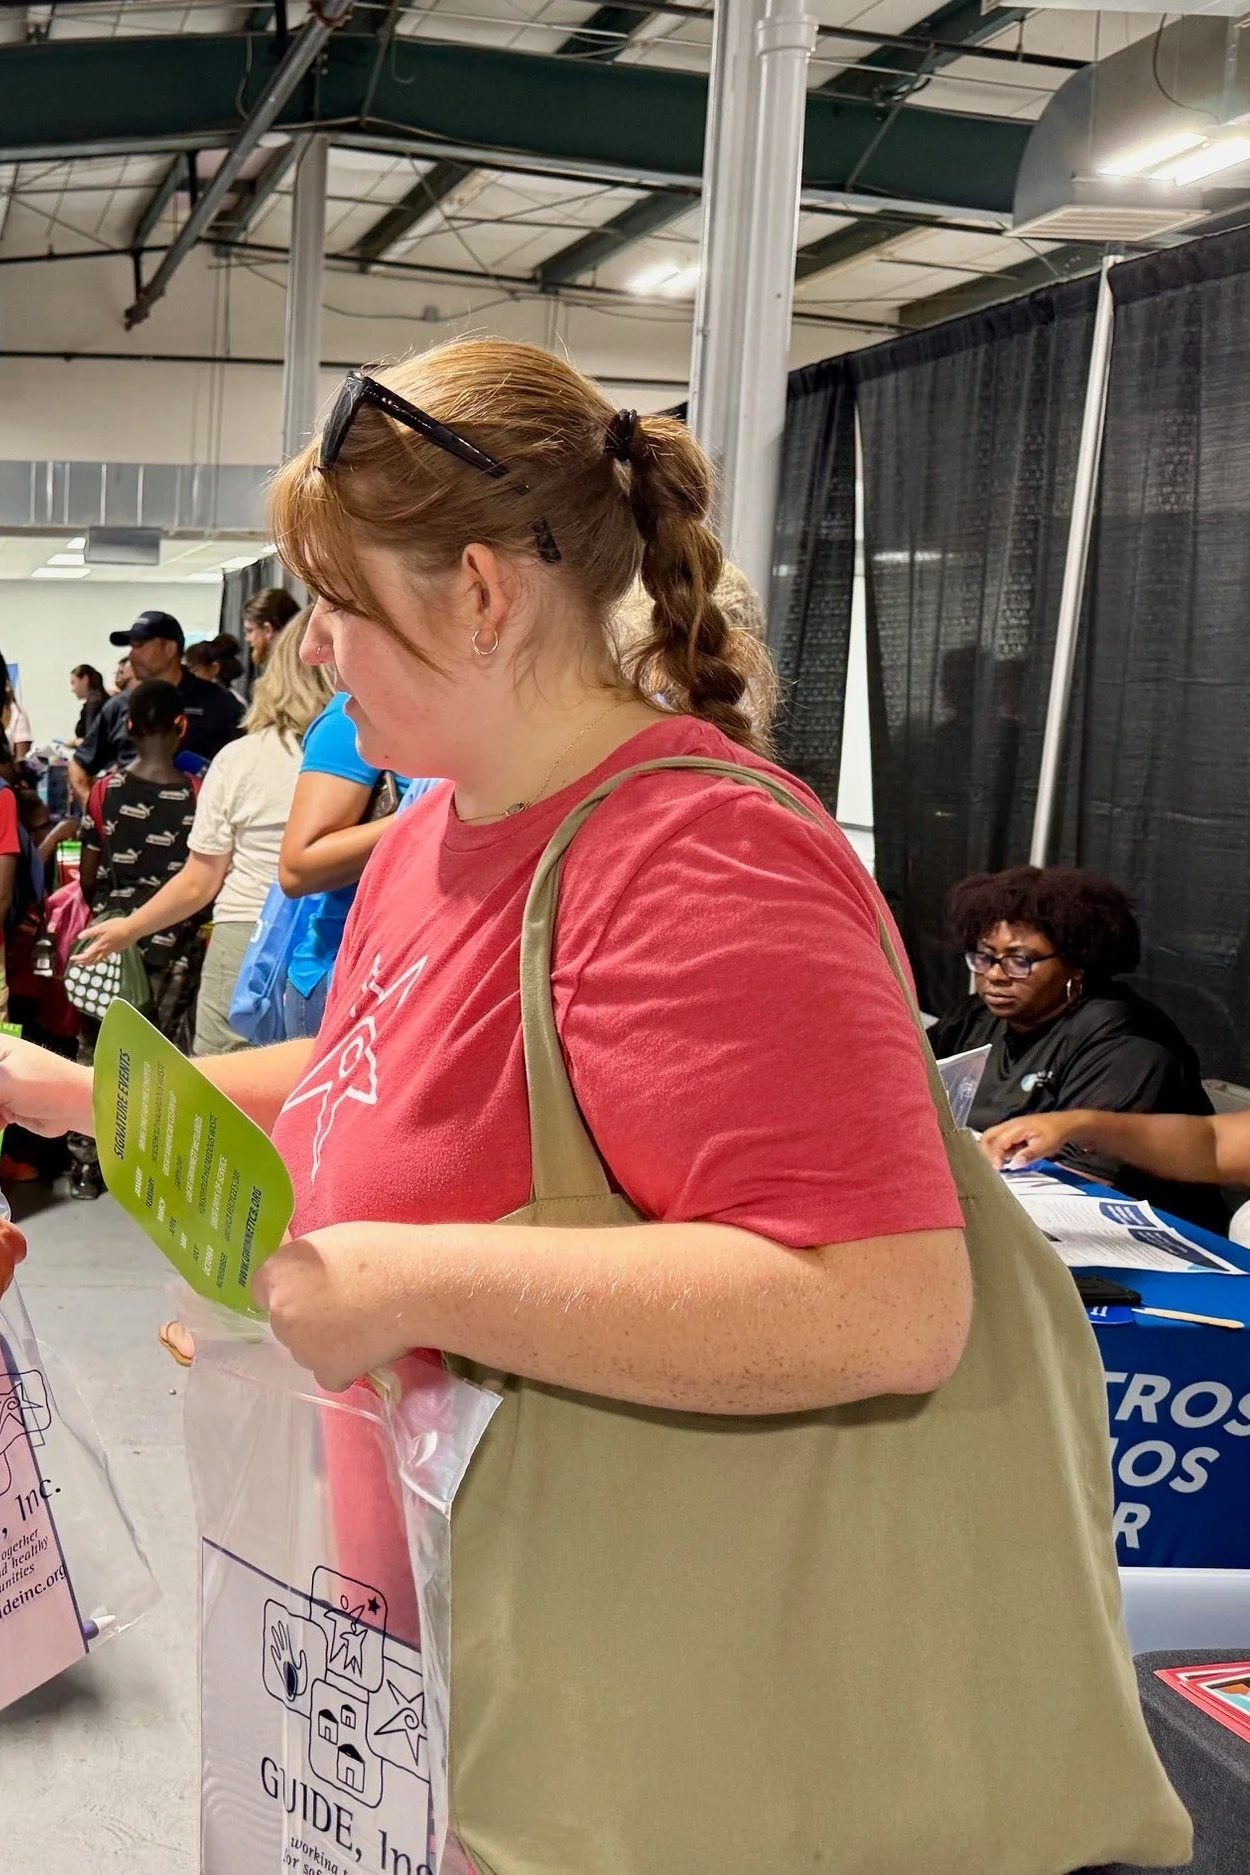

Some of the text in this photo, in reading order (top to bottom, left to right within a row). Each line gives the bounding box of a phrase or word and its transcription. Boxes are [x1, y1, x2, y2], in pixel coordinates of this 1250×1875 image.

[114, 1049, 131, 1160] SIGNATURE EVENTS
[146, 1176, 155, 1208] FEBRUARY
[157, 1197, 166, 1222] MARCH
[238, 1187, 262, 1289] WWW.GWINNETTCB.ORG
[1105, 1371, 1250, 1437] ROS
[1110, 1437, 1220, 1494] OS
[14, 1479, 61, 1521] Inc.
[12, 1536, 49, 1568] healthy
[261, 1756, 433, 1875] GUIDE, In
[283, 1853, 299, 1868] or
